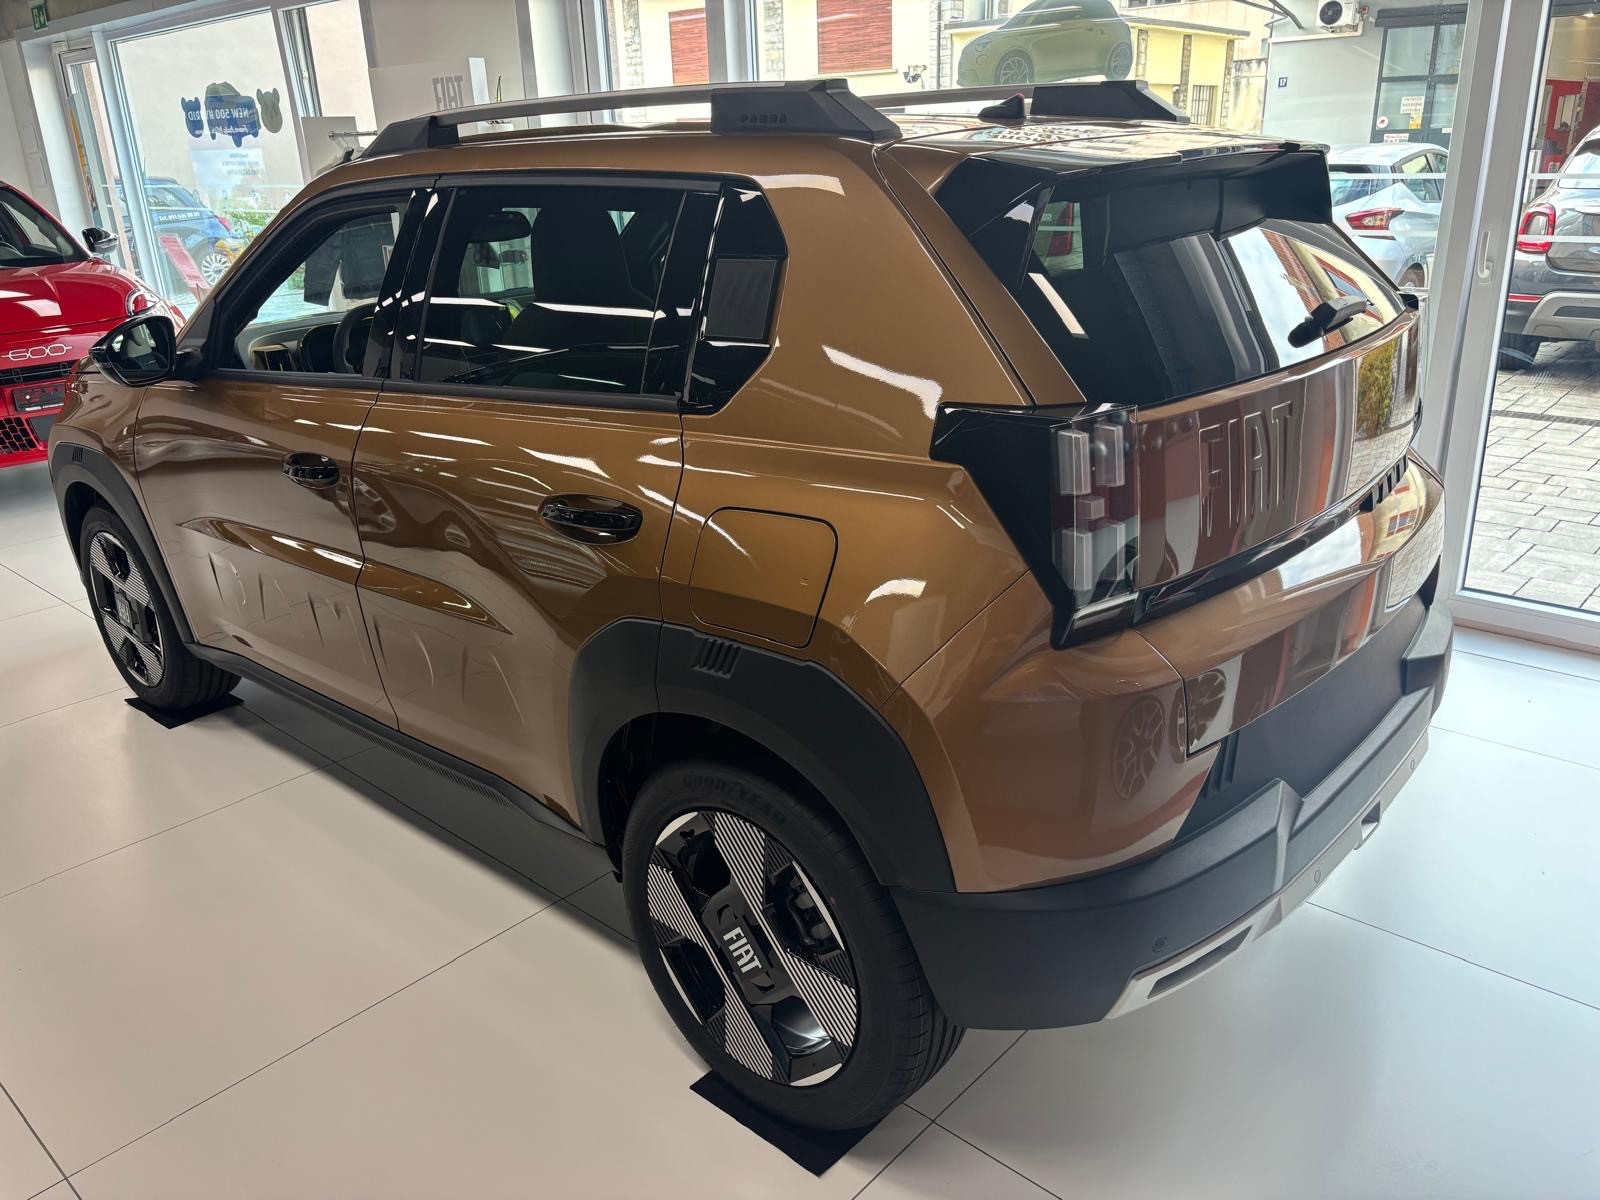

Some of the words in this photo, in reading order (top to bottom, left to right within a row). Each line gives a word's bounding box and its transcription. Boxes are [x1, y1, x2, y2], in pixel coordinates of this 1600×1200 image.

[432, 75, 463, 111] FIAT
[740, 113, 788, 124] PANDA
[6, 343, 68, 361] 600
[1199, 400, 1294, 538] FIAT
[723, 926, 762, 973] FIAT
